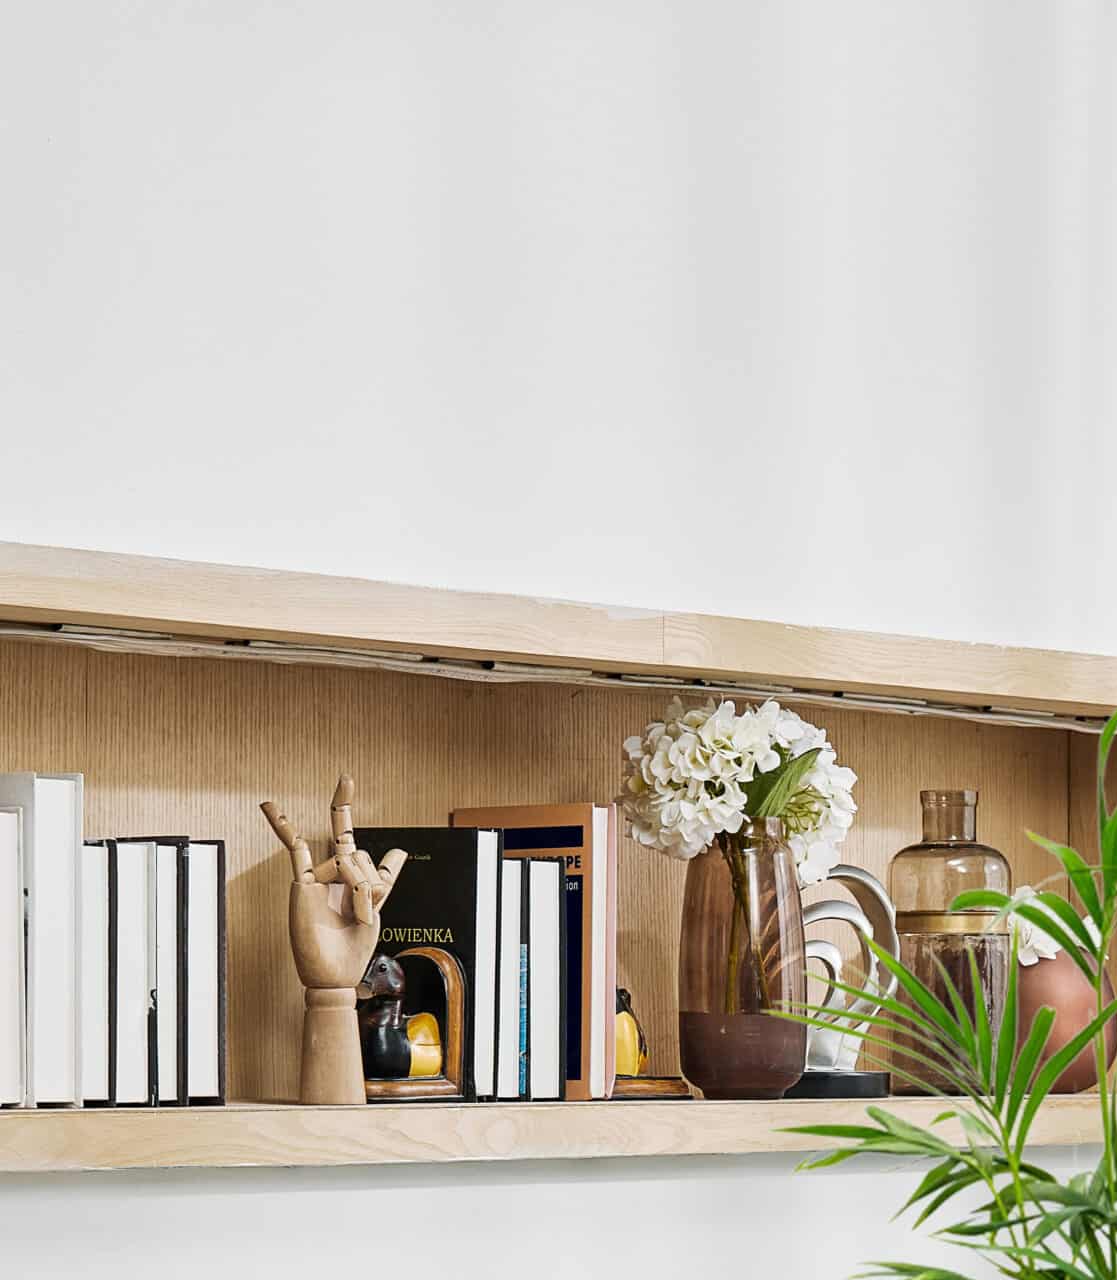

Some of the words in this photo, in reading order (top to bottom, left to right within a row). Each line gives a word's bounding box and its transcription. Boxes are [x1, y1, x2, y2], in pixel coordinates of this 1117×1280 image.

[565, 855, 582, 869] PE
[566, 878, 579, 891] ion
[380, 927, 454, 943] OWIENKA
